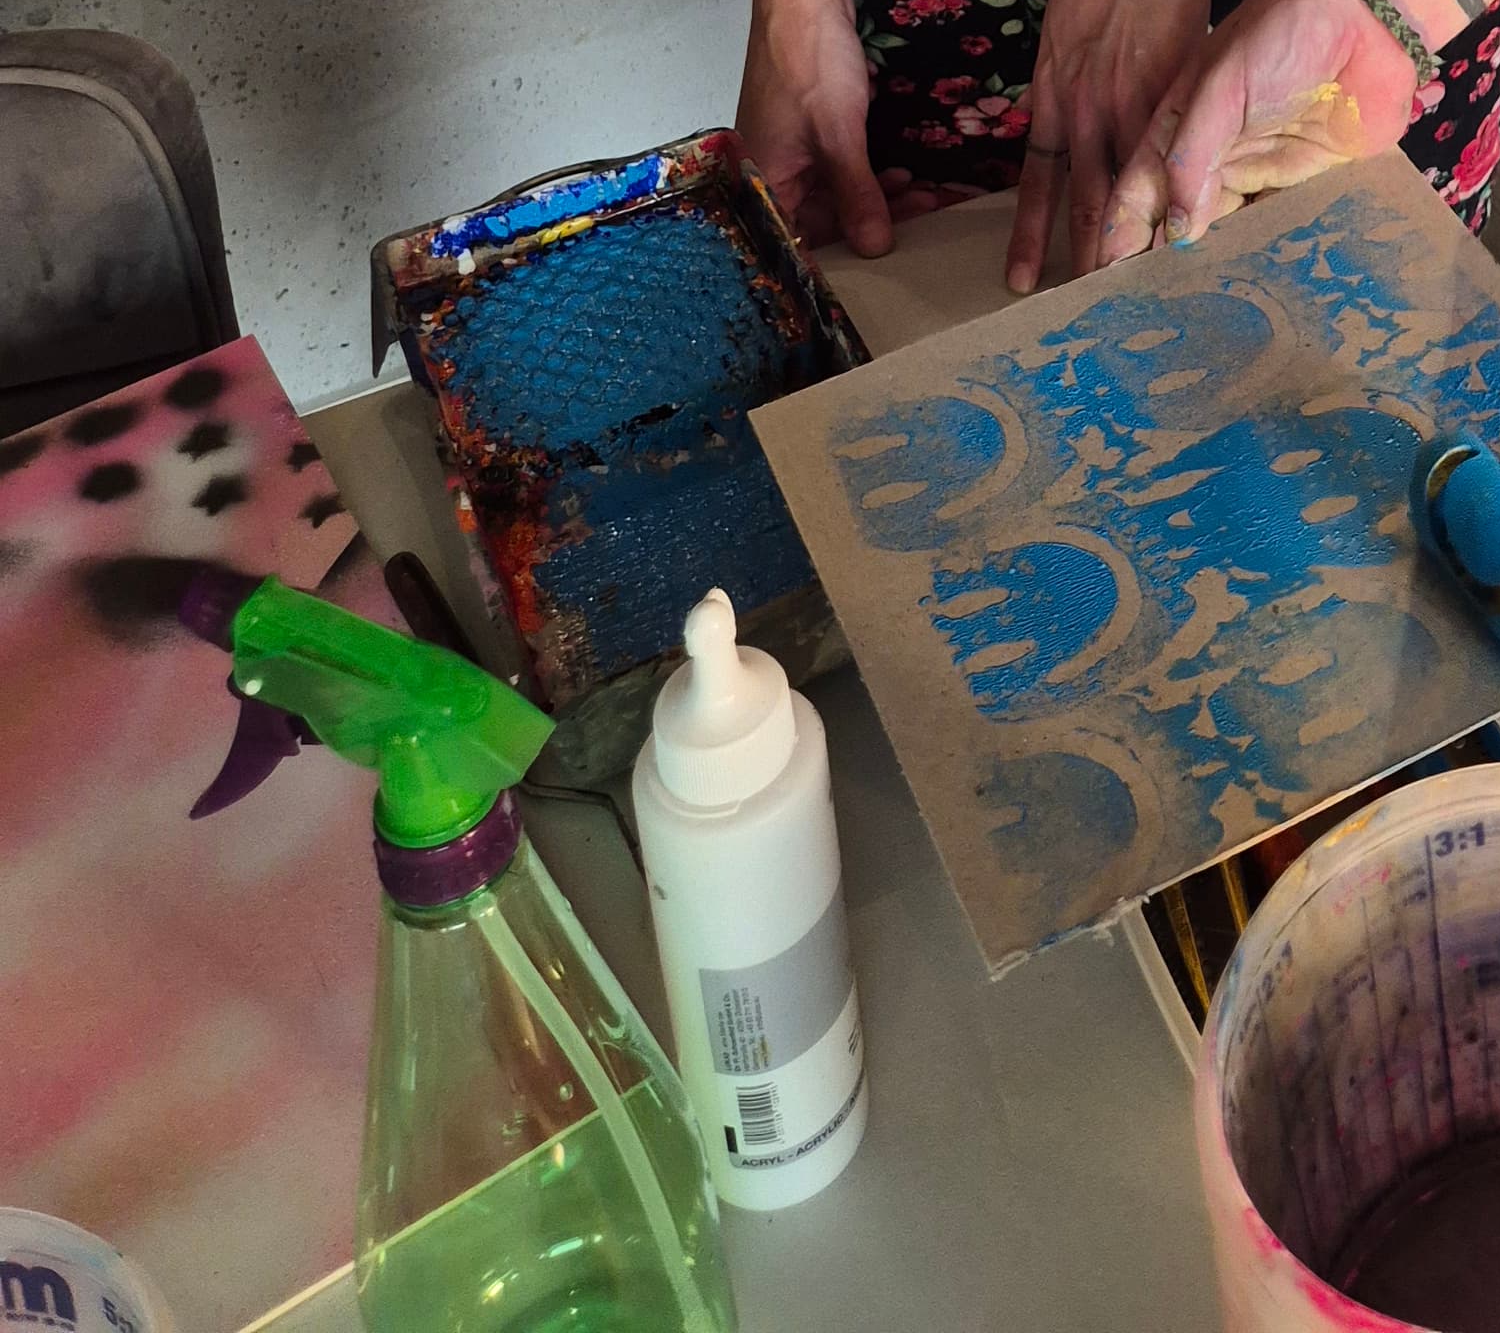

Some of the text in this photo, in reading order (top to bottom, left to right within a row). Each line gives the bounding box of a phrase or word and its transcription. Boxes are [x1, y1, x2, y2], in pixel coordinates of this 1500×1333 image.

[1434, 820, 1486, 857] 3:1
[742, 1155, 785, 1167] ACRYL
[796, 1113, 844, 1157] ACRYLIC
